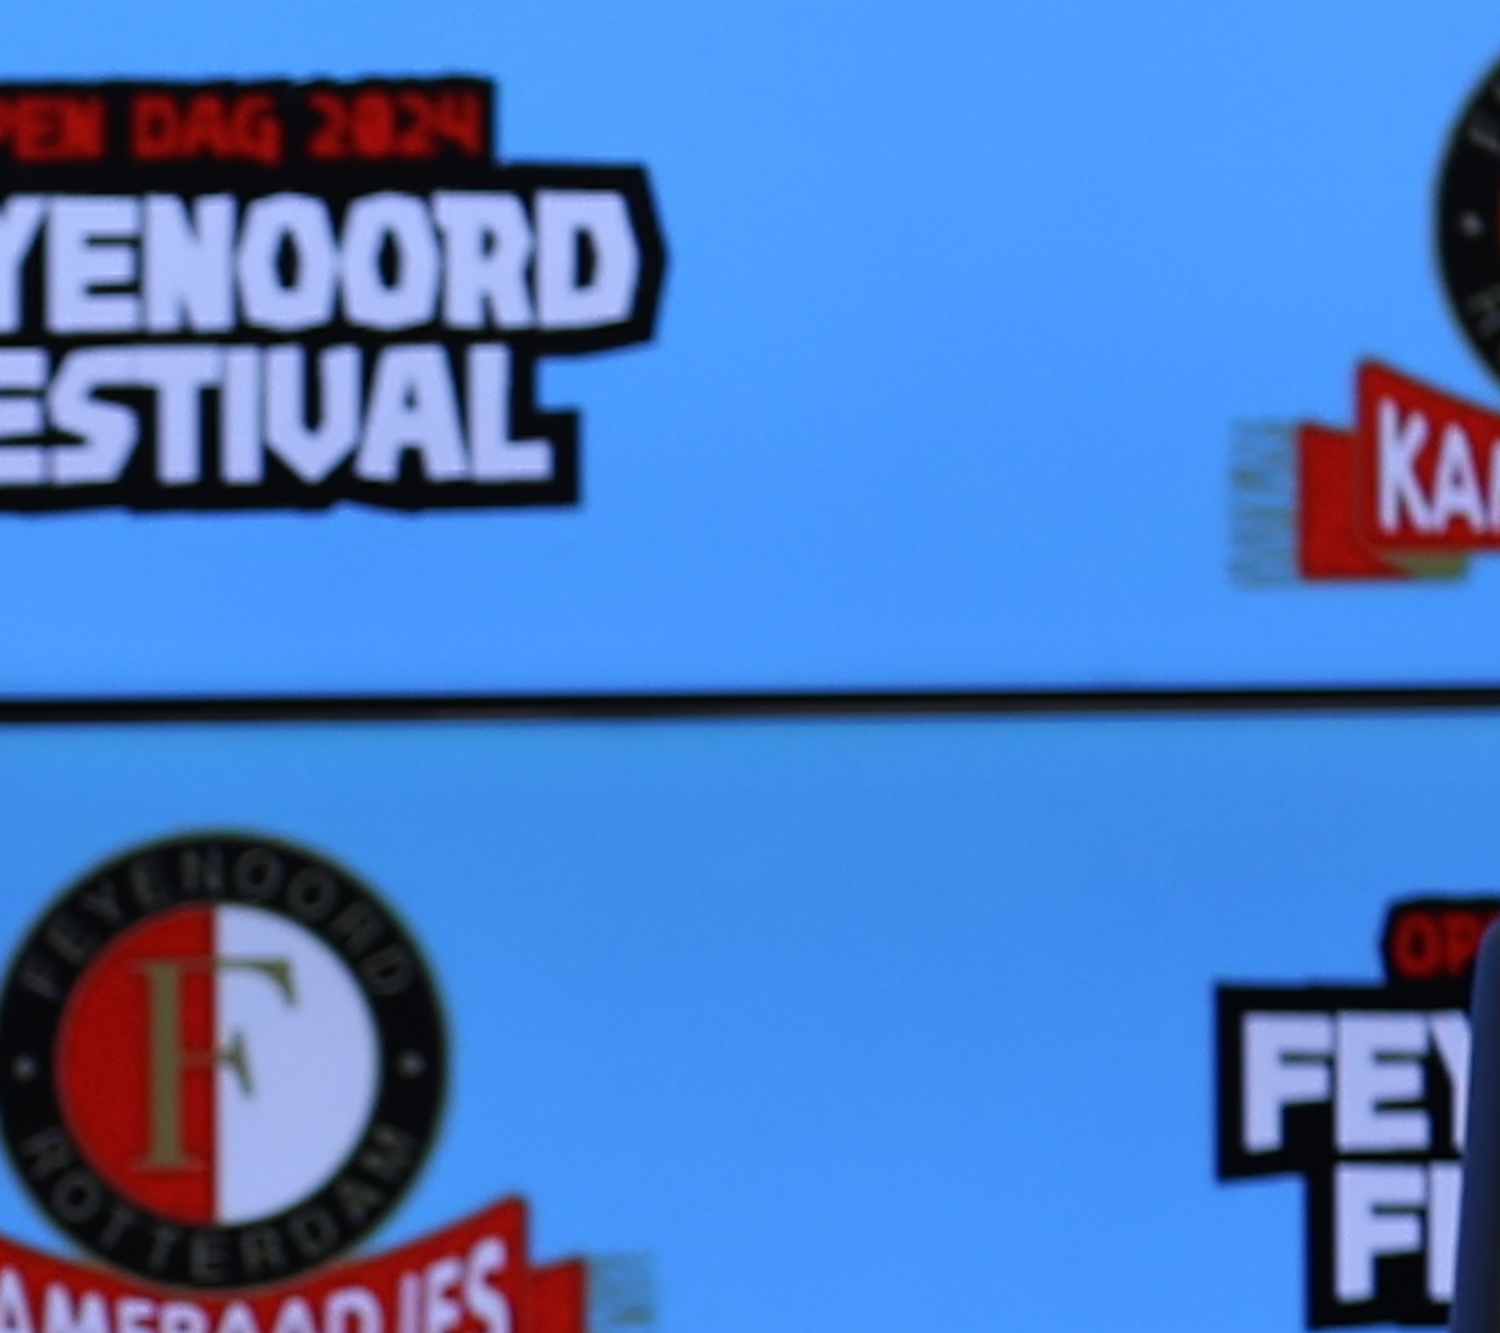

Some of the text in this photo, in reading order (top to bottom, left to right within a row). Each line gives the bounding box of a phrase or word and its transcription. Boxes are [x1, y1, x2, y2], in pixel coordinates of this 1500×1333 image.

[129, 92, 285, 168] DAG
[307, 88, 484, 162] 2024
[18, 846, 415, 1002] FEYENOORD
[17, 1122, 417, 1284] ROTTERDAM
